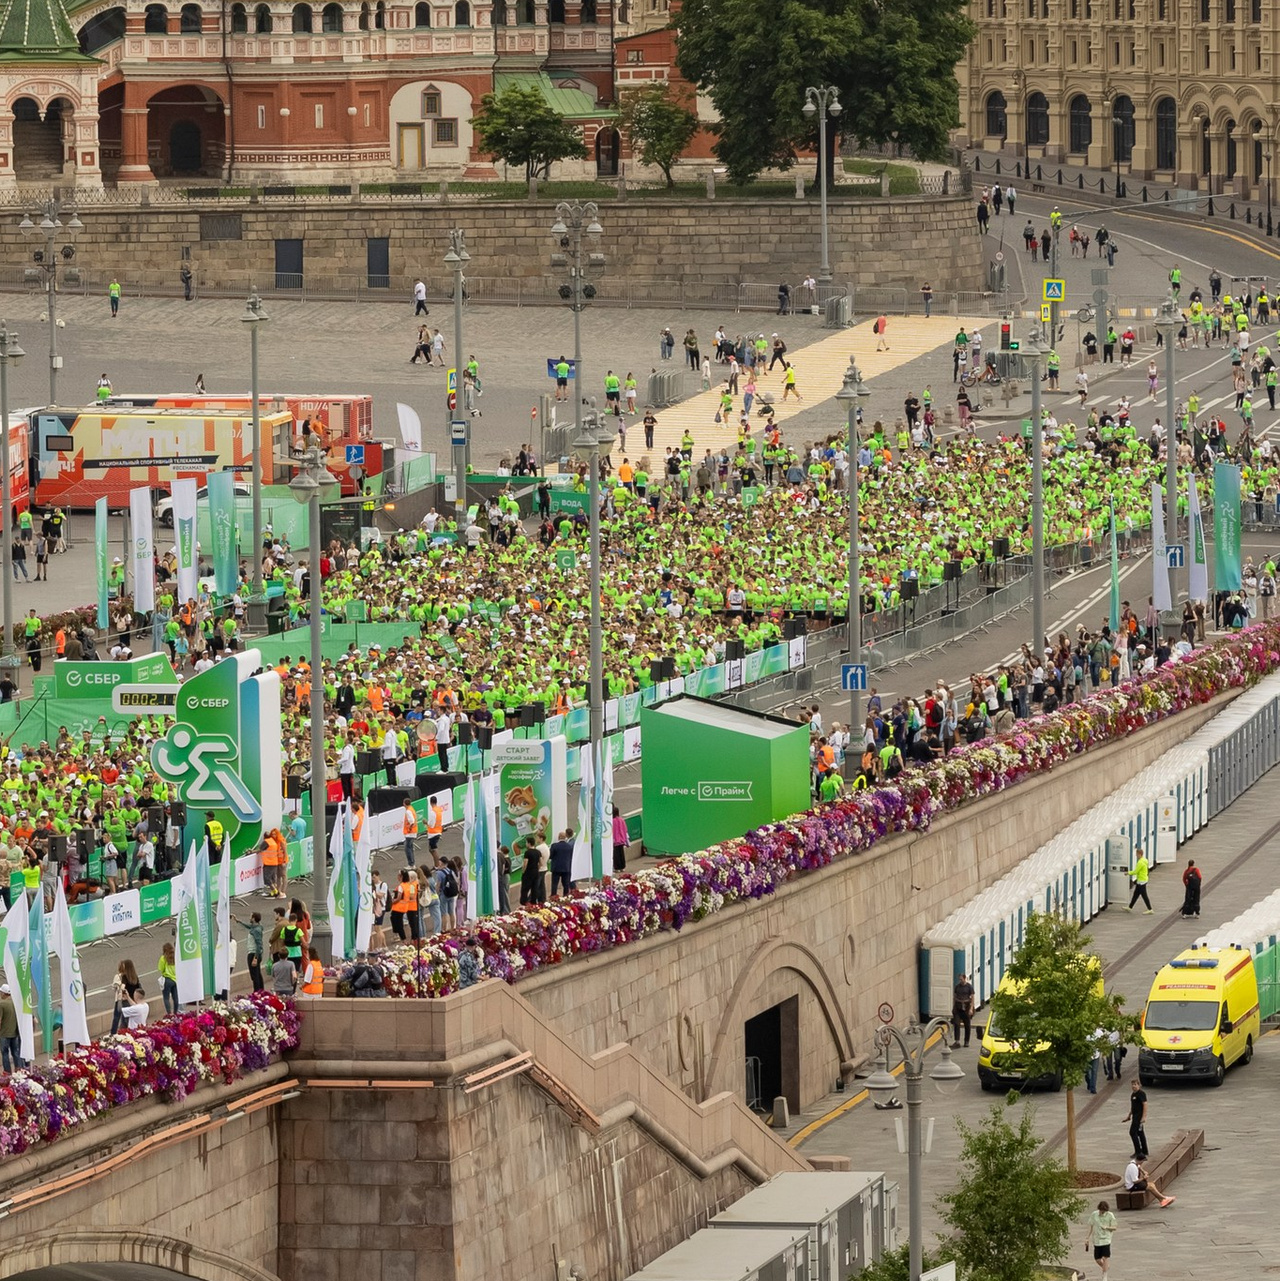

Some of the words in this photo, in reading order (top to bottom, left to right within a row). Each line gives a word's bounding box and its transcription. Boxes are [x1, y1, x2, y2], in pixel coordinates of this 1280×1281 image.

[99, 459, 139, 467] НАЦИОНАЛЬНЫЙ
[140, 457, 172, 466] СПОРТИВНЫЙ
[173, 456, 203, 464] ТЕЛЕКАНАЛ
[561, 499, 583, 508] ВОДА
[745, 493, 754, 504] D
[85, 673, 121, 685] СБЕР
[201, 699, 230, 708] СБЕР
[661, 787, 689, 795] Легче
[714, 786, 745, 796] Прайм
[112, 910, 133, 924] КУЛЬТУРА
